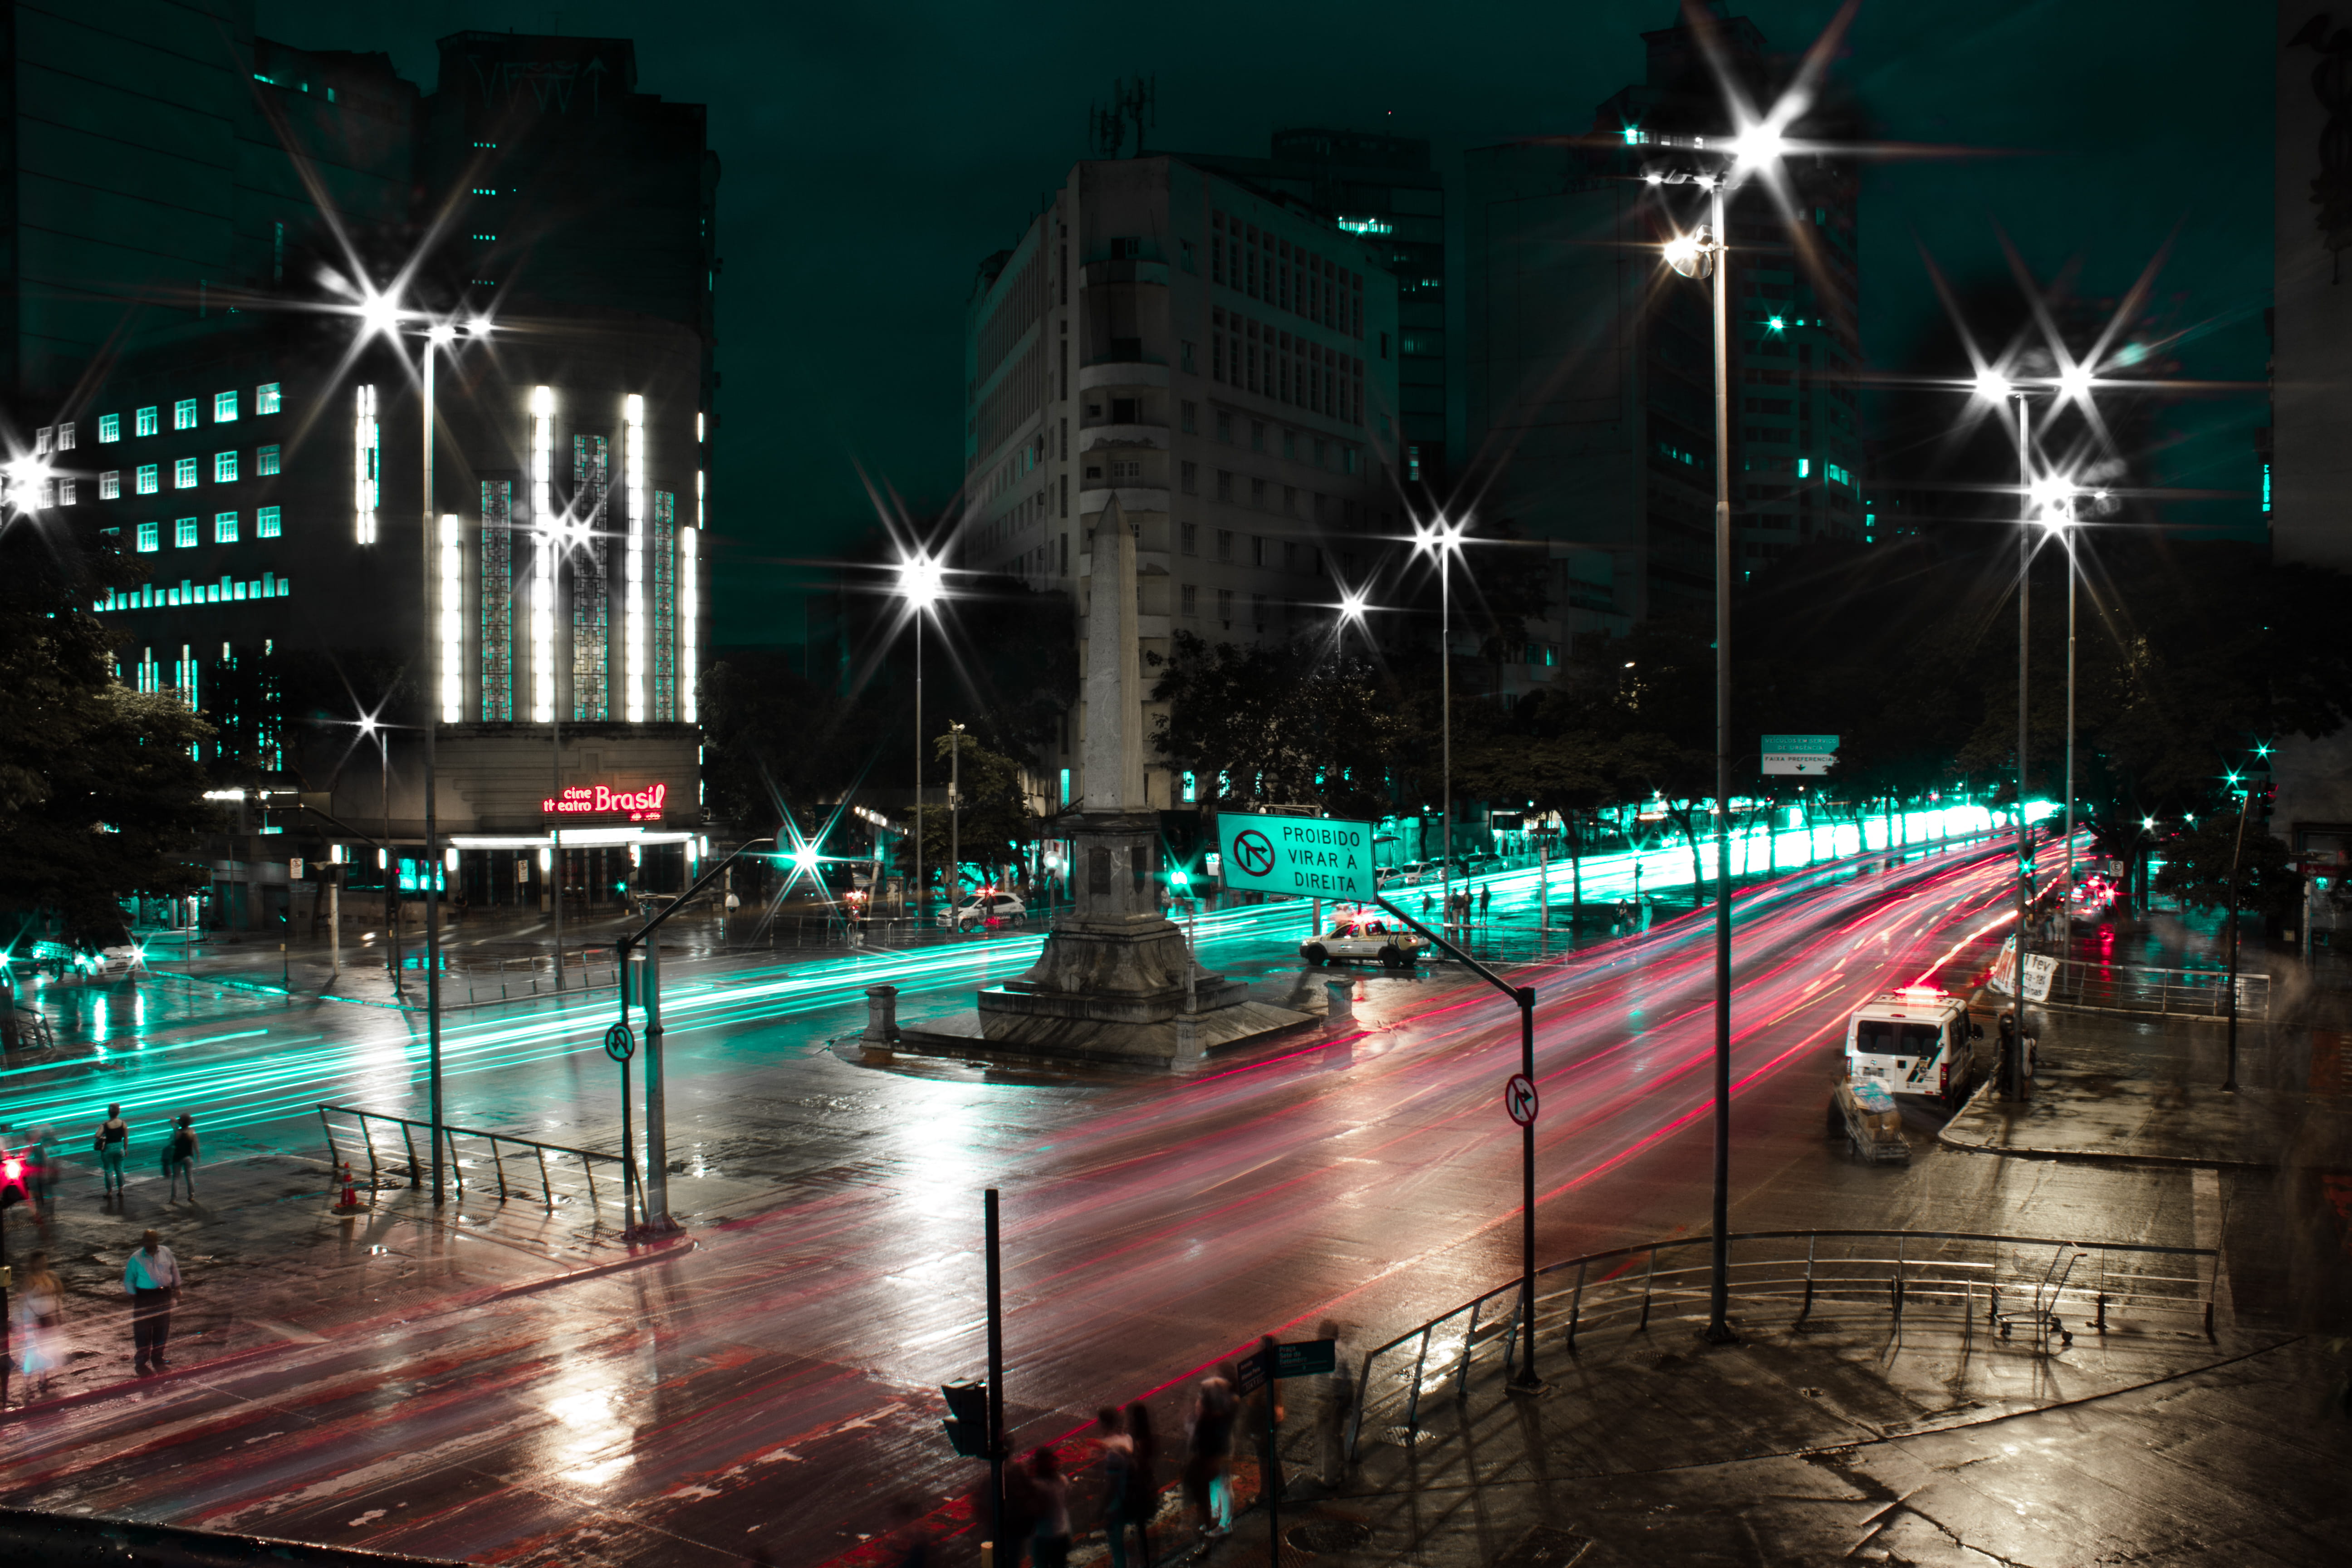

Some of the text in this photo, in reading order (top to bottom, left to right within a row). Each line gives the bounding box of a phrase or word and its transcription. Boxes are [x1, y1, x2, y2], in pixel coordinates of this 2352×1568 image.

[564, 787, 592, 799] cine
[594, 784, 665, 811] Brasil
[1283, 826, 1360, 847] PROIBIDO
[1288, 848, 1358, 870] VIRAR À
[1294, 872, 1357, 893] DIREITA
[2033, 955, 2051, 972] fev
[1279, 1345, 1296, 1353] Praça
